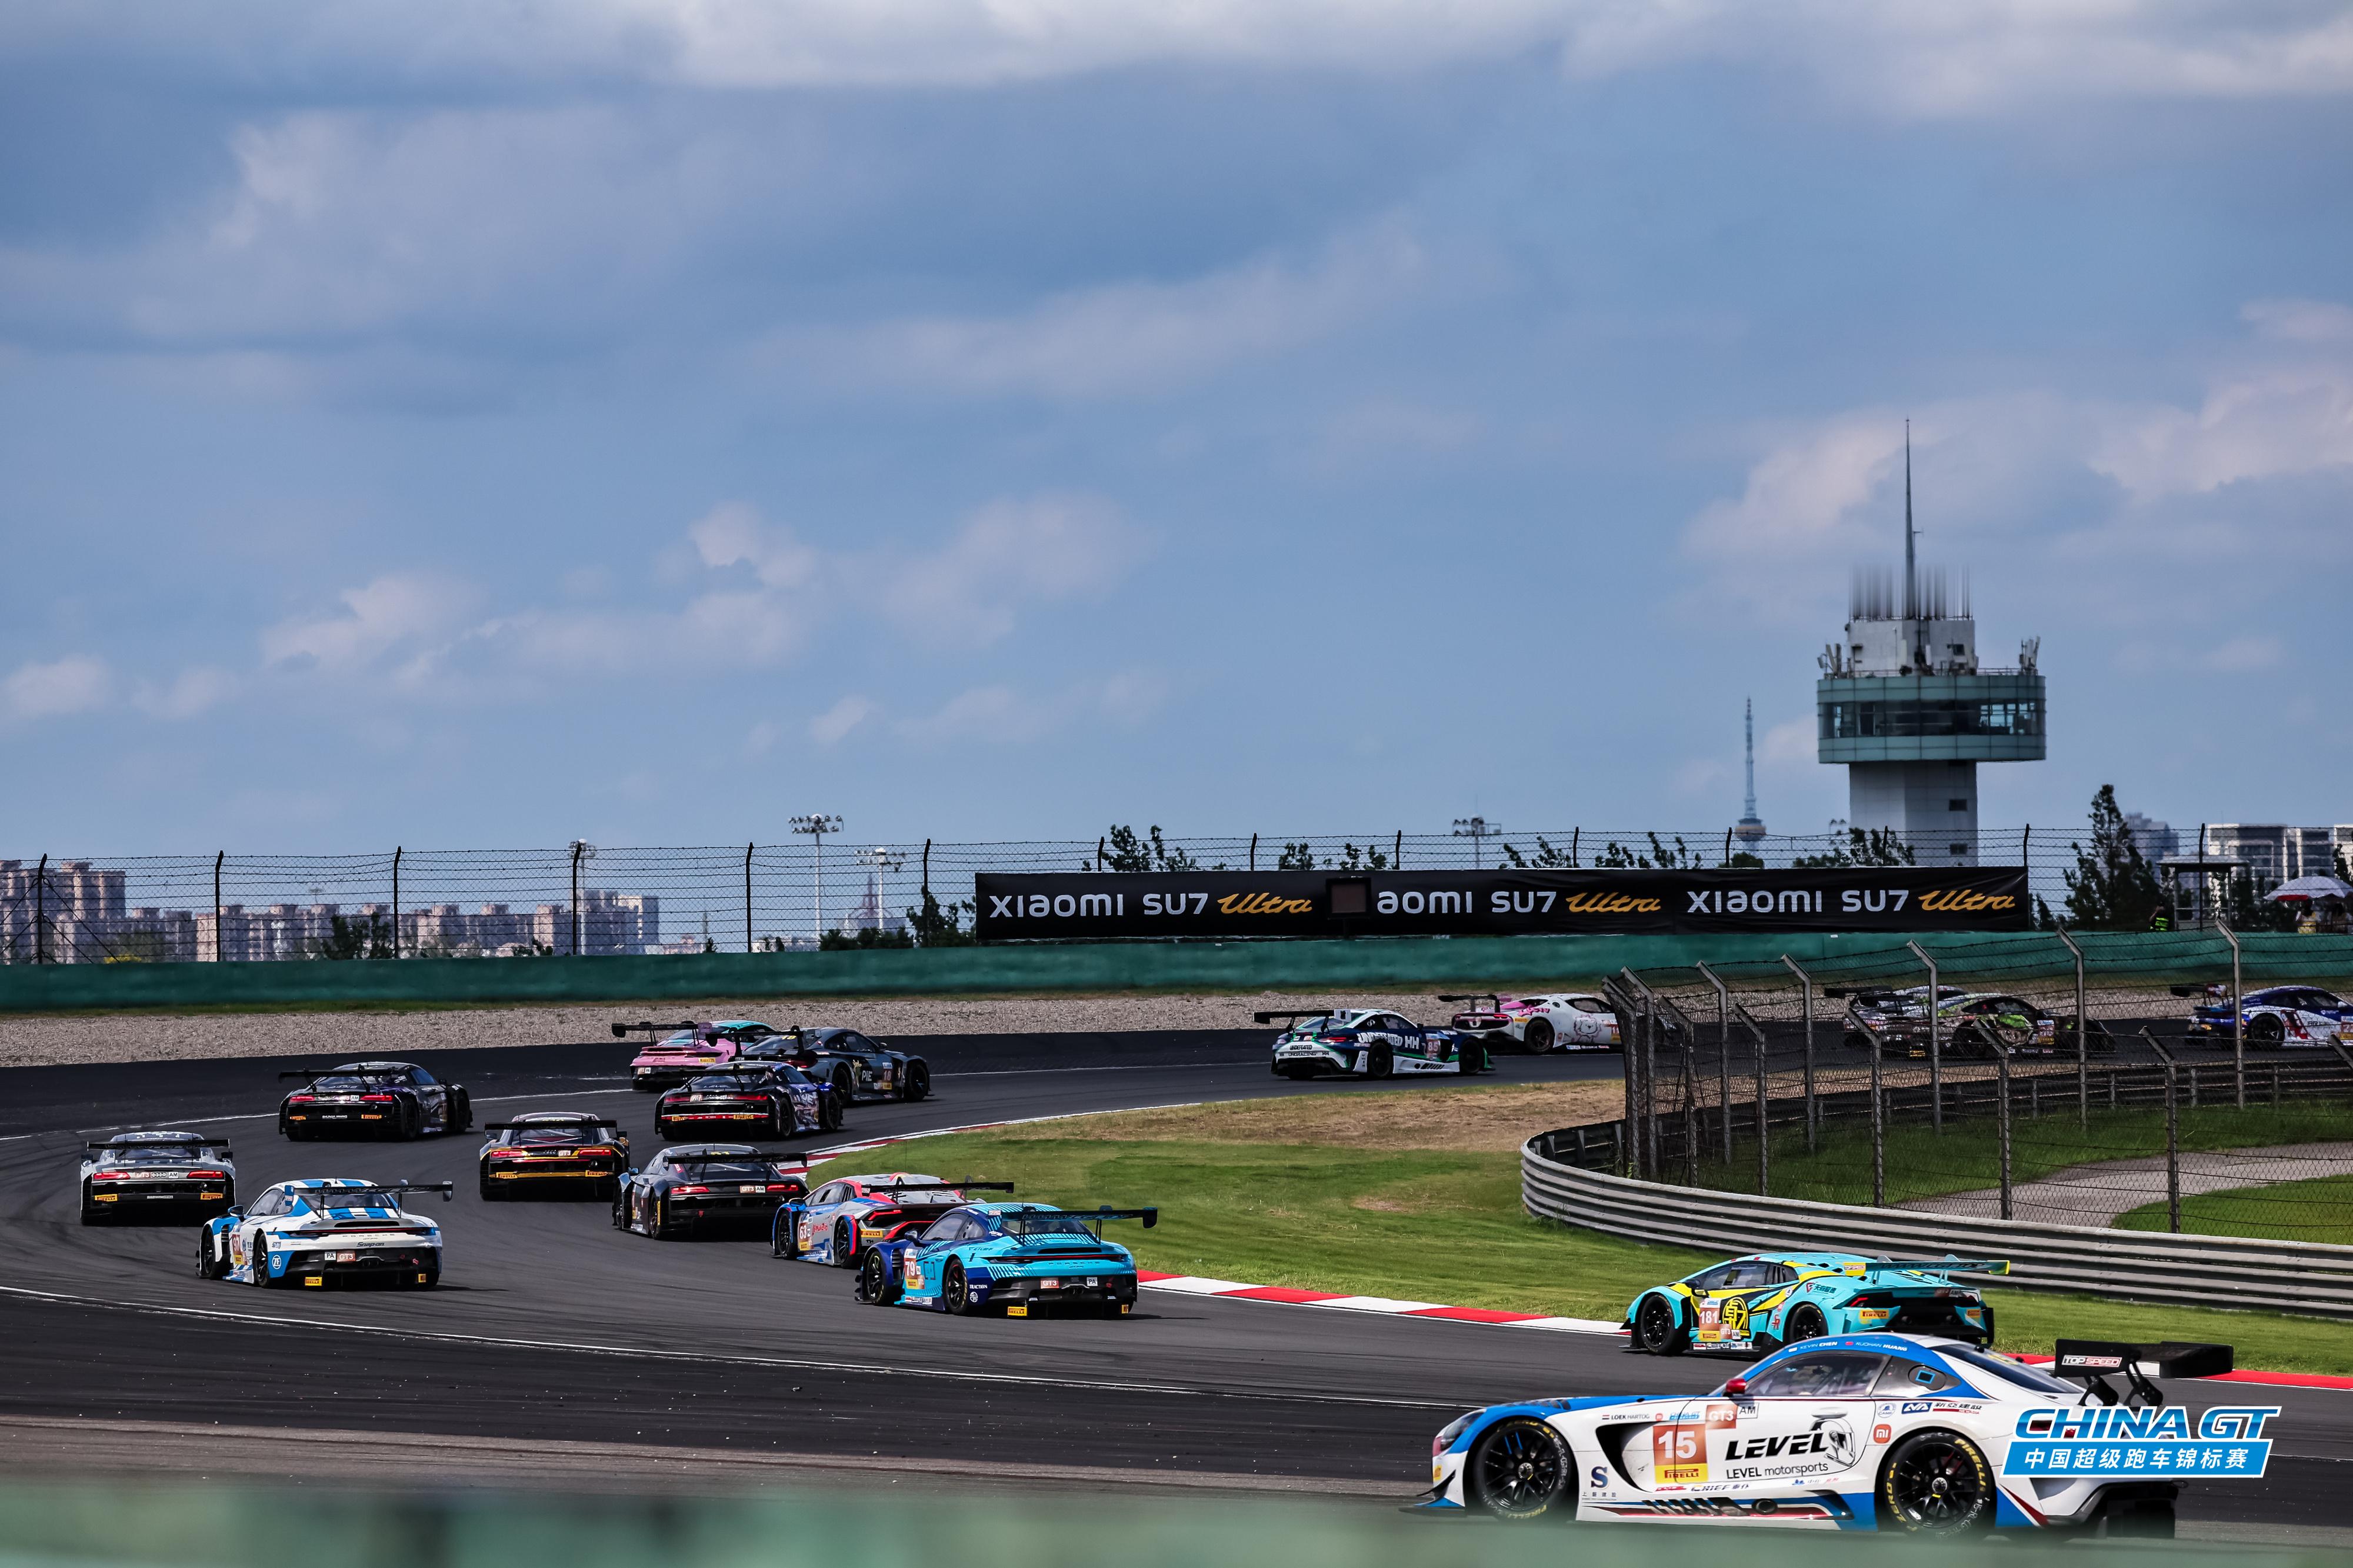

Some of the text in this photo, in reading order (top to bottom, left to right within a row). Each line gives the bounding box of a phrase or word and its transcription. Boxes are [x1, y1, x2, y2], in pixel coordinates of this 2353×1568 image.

[1143, 893, 1209, 915] SU7
[1217, 892, 1312, 915] Ultra
[1491, 891, 1557, 913] SU7
[1566, 891, 1661, 913] Ultra
[1842, 889, 1909, 912] SU7
[1918, 889, 2016, 912] Ultra
[1428, 1040, 1439, 1051] 85
[861, 1070, 873, 1082] PIE
[799, 1225, 807, 1239] 63
[233, 1237, 241, 1251] 97
[905, 1261, 916, 1276] 79
[1699, 1310, 1719, 1324] 181
[1882, 1343, 1908, 1352] HUANG
[2063, 1356, 2121, 1366] TOP SPEED
[1709, 1410, 1734, 1423] GT3
[1739, 1405, 1756, 1415] AM
[1658, 1430, 1697, 1459] 15
[1725, 1432, 1829, 1461] LEVEL
[1954, 1439, 1987, 1486] PIRELLI
[1664, 1468, 1699, 1479] PIRELLI
[1726, 1462, 1829, 1479] LEVEL motorsports
